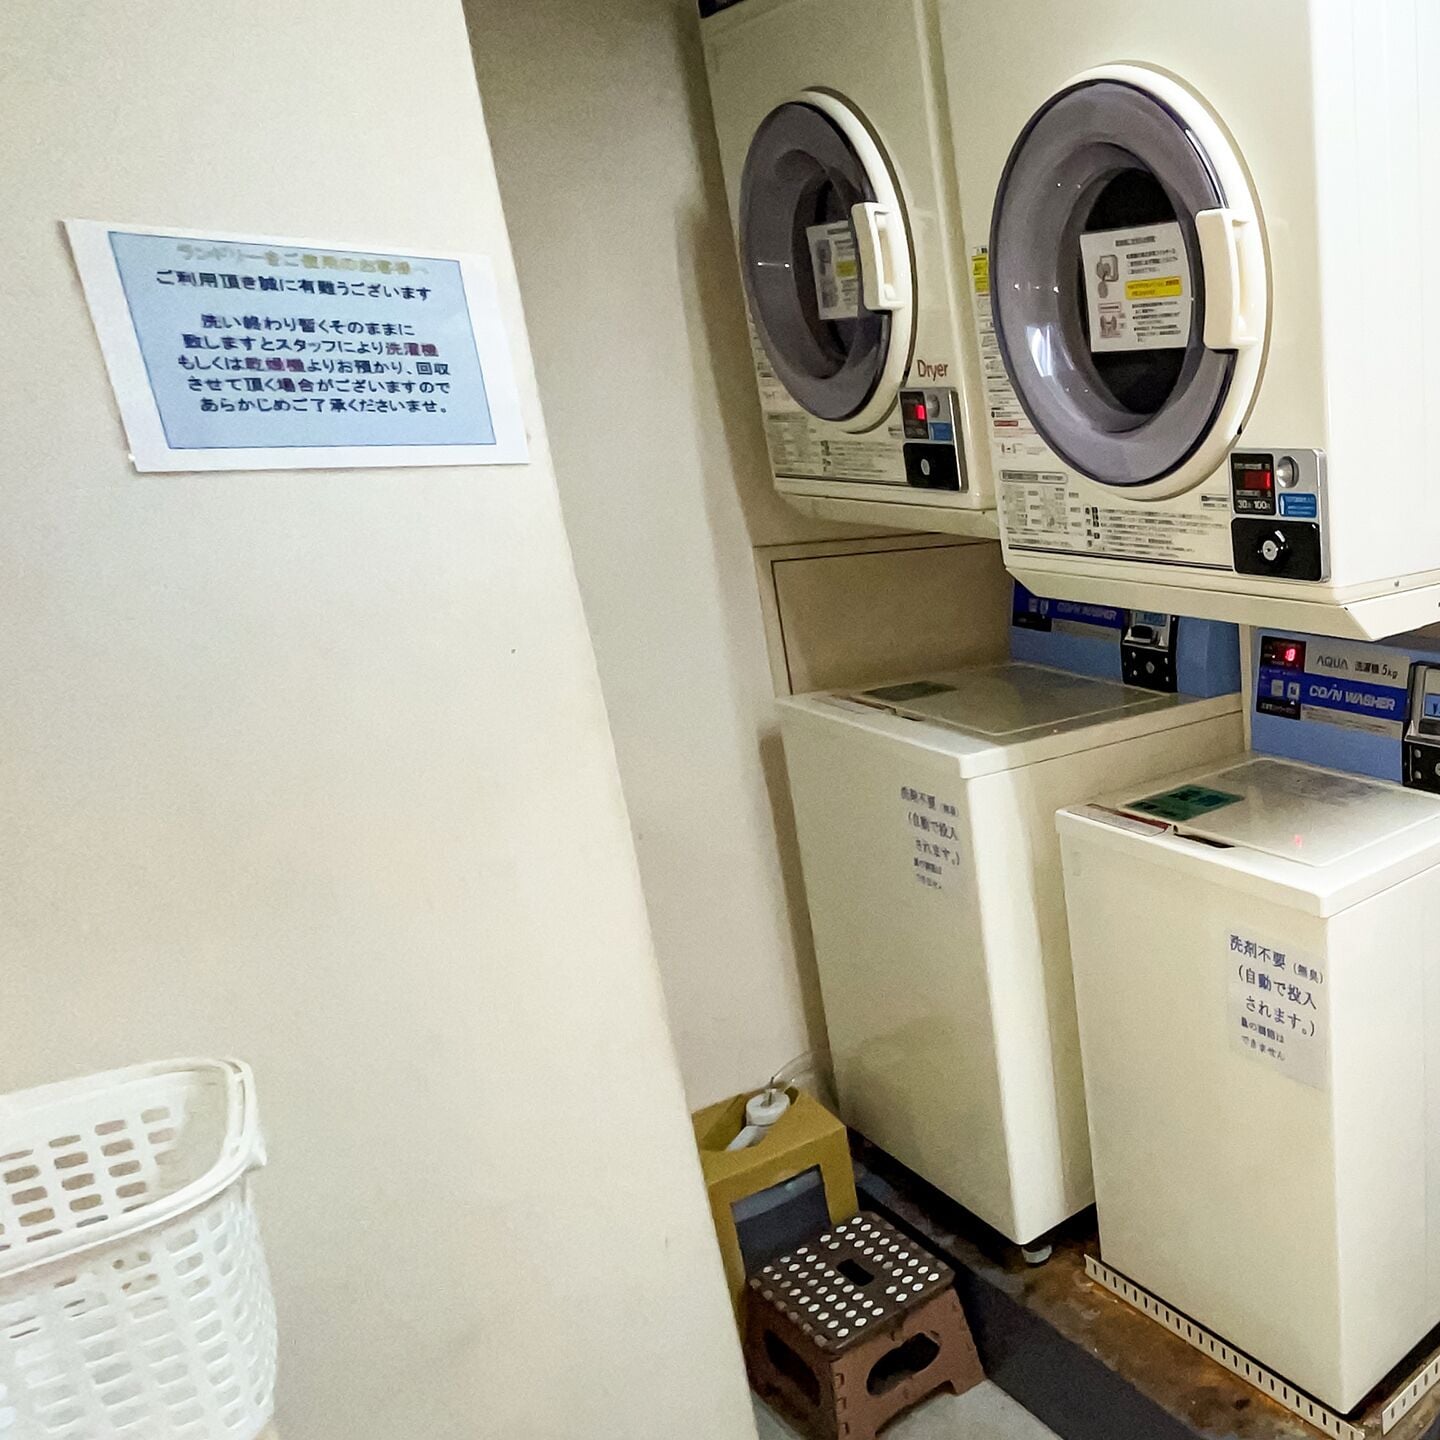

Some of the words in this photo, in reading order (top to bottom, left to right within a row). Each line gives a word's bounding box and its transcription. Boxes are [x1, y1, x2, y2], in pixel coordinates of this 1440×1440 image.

[201, 313, 416, 337] 洗い終わり暫くそのままに
[182, 333, 440, 357] 致しますとスタッフにより洗濯機
[178, 355, 450, 376] もしくは乾燥機よりお預かり、回収
[917, 359, 949, 382] Dryer
[187, 375, 451, 395] させて頂く場合がございますので
[200, 397, 448, 414] あらかじめご了承くださいませ。
[1316, 654, 1348, 670] AQUA
[1381, 664, 1398, 680] 5kg
[1344, 691, 1396, 711] WASHER
[1230, 934, 1286, 971] 洗剤不要
